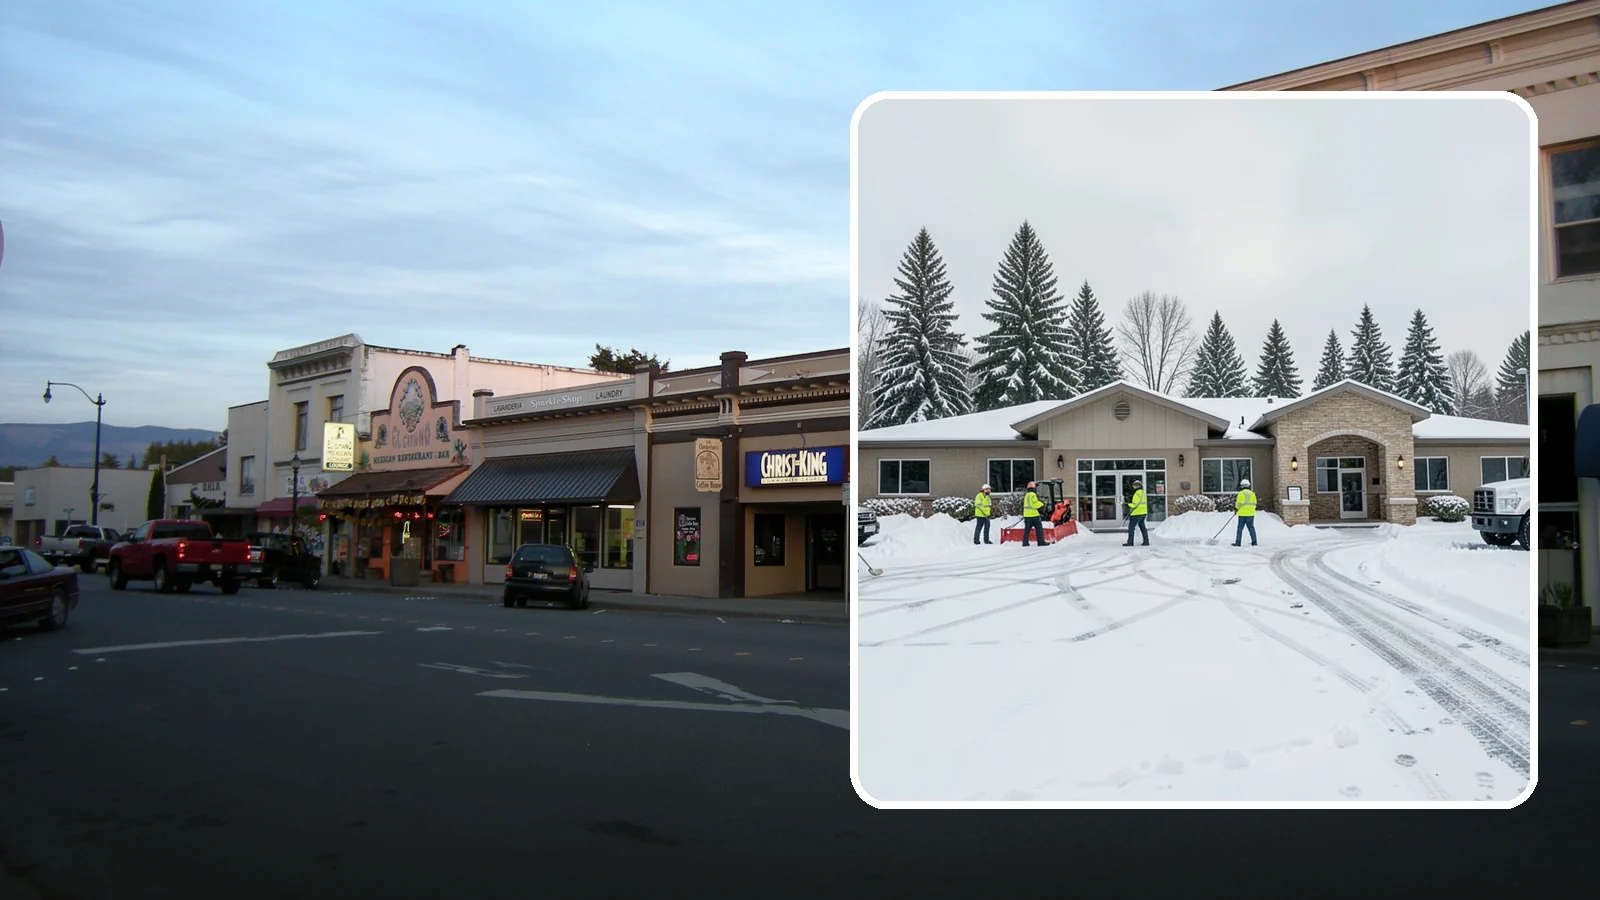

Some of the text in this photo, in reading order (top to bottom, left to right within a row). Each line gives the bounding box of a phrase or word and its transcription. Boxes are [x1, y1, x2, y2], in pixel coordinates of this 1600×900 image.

[595, 389, 624, 400] LAUNDRY
[493, 402, 523, 413] LAVANDERIA
[530, 394, 583, 409] Sparkle Shop
[397, 452, 433, 462] RESTAURANT
[438, 450, 450, 459] BAR
[761, 450, 827, 478] CHRIST KING
